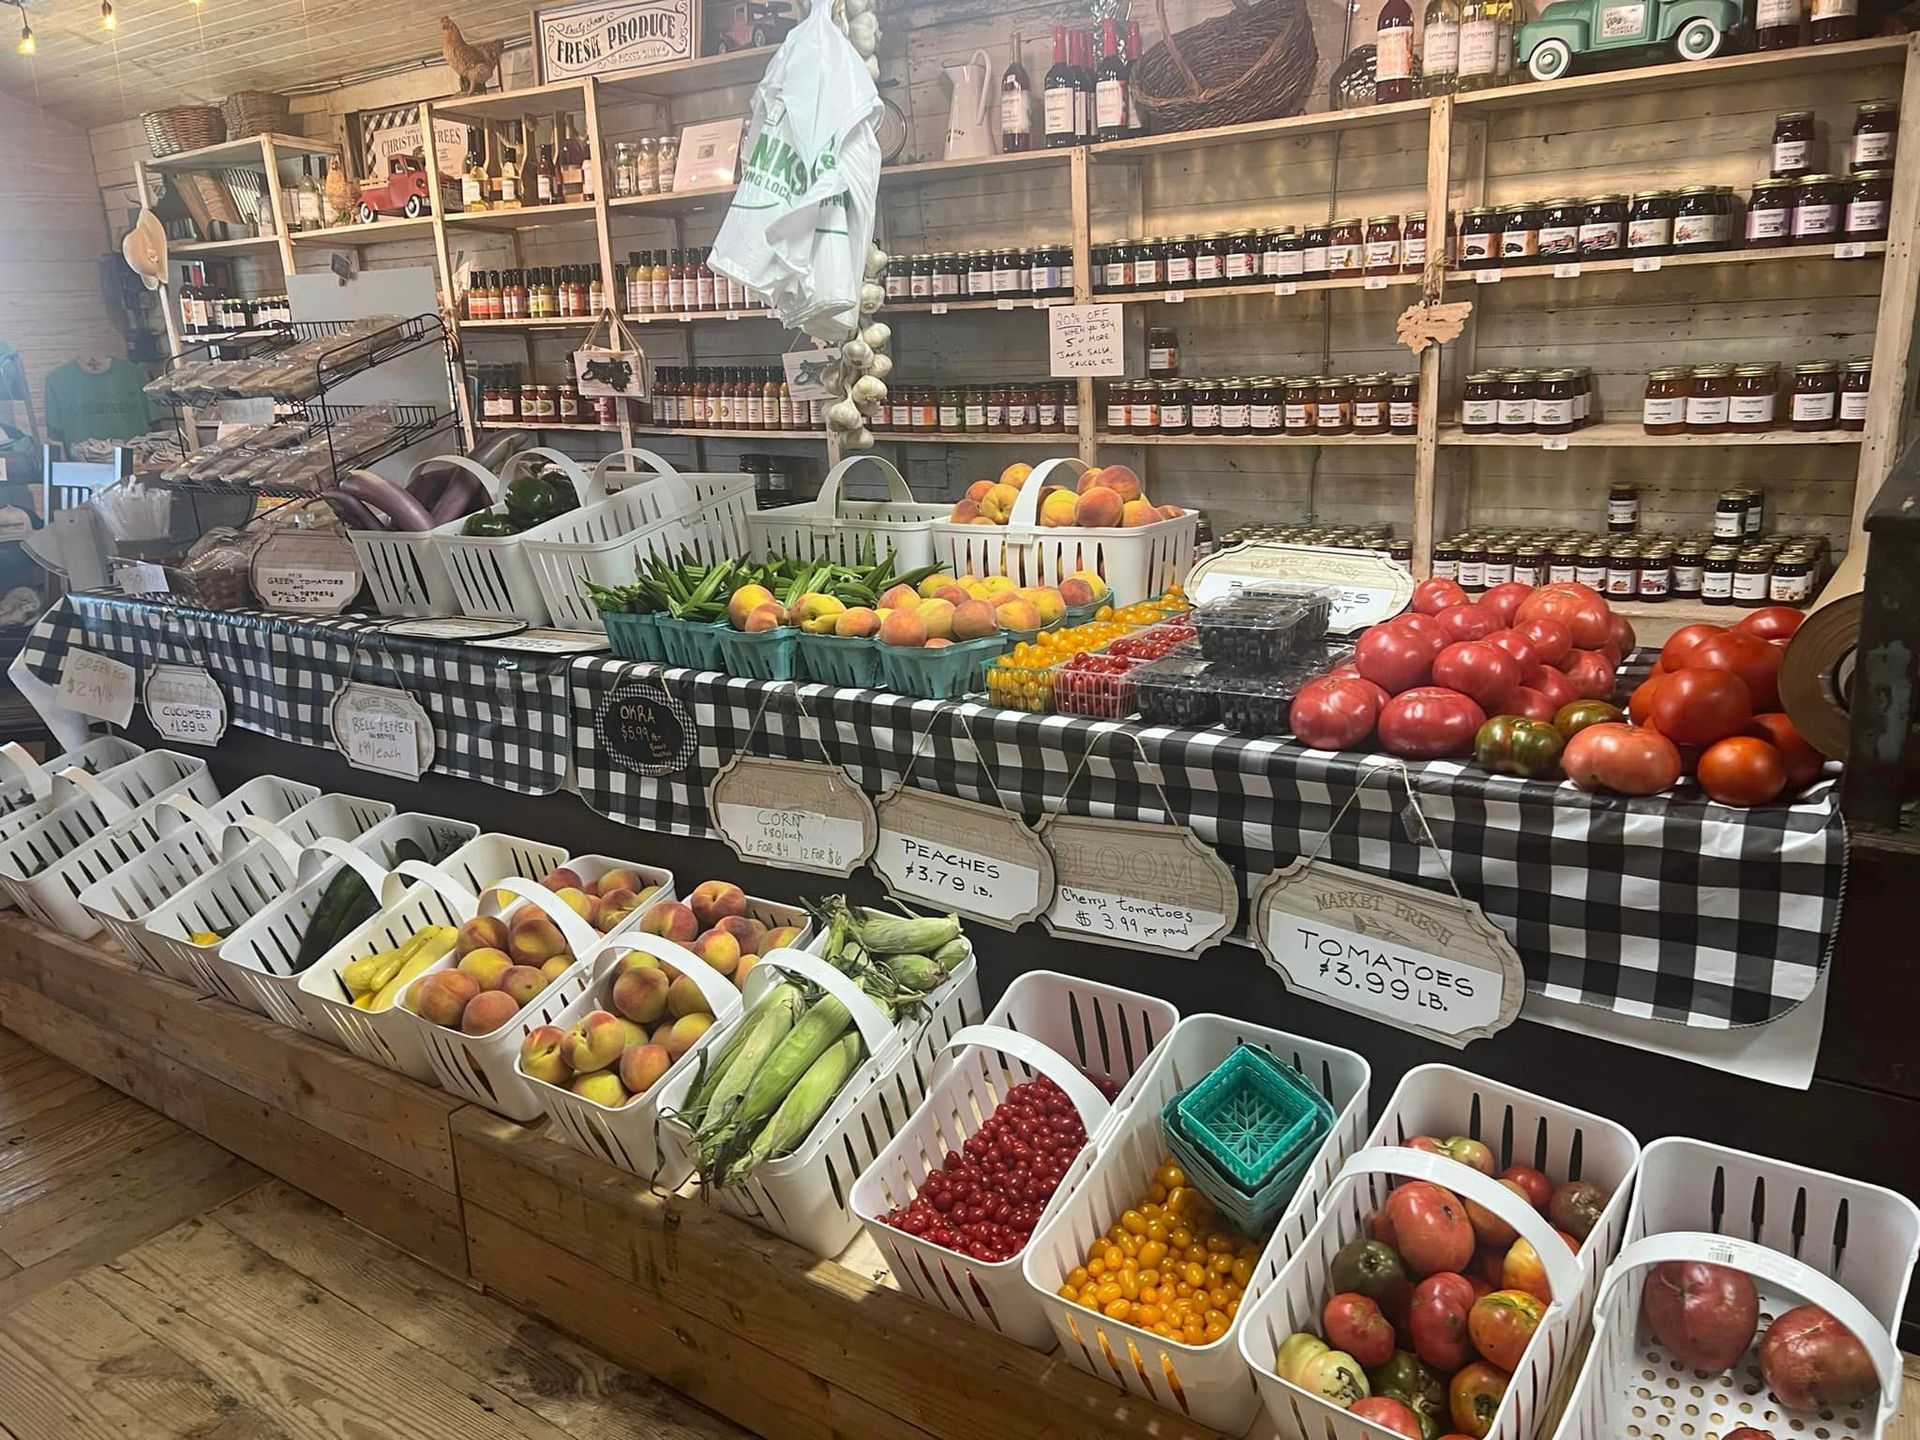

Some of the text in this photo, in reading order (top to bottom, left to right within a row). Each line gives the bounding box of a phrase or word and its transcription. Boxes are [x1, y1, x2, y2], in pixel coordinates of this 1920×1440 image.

[557, 13, 676, 64] FRESH PRODUCE
[381, 127, 462, 158] CHRISTM REES
[1056, 308, 1110, 328] 20% OFF
[1064, 326, 1086, 336] WHEN
[1066, 338, 1076, 348] 5
[1088, 333, 1110, 342] MORE
[1056, 350, 1082, 359] JAMS
[1069, 361, 1097, 369] SAUCES
[1250, 557, 1361, 578] MARKET FRESH
[267, 577, 344, 586] GREEN TOMATOES
[74, 654, 112, 674] GREEN
[162, 706, 212, 720] CUCUMBER
[620, 704, 656, 724] OKRA
[352, 716, 413, 734] BELL PEPPERS
[621, 722, 650, 742] $5.99
[757, 810, 804, 827] CORN
[746, 836, 842, 866] 6 FOR $4 12 FOR $6
[901, 838, 1000, 880] PEACHES
[1054, 840, 1197, 891] BLOOM
[905, 861, 966, 892] $3.79
[1061, 888, 1193, 924] Cherry tomatoes
[1075, 910, 1189, 938] $ 3.99 per pound
[1315, 892, 1454, 947] MARKET FRESH
[1297, 928, 1474, 998] TOMATOES
[1319, 958, 1448, 1012] $3.99 LB.
